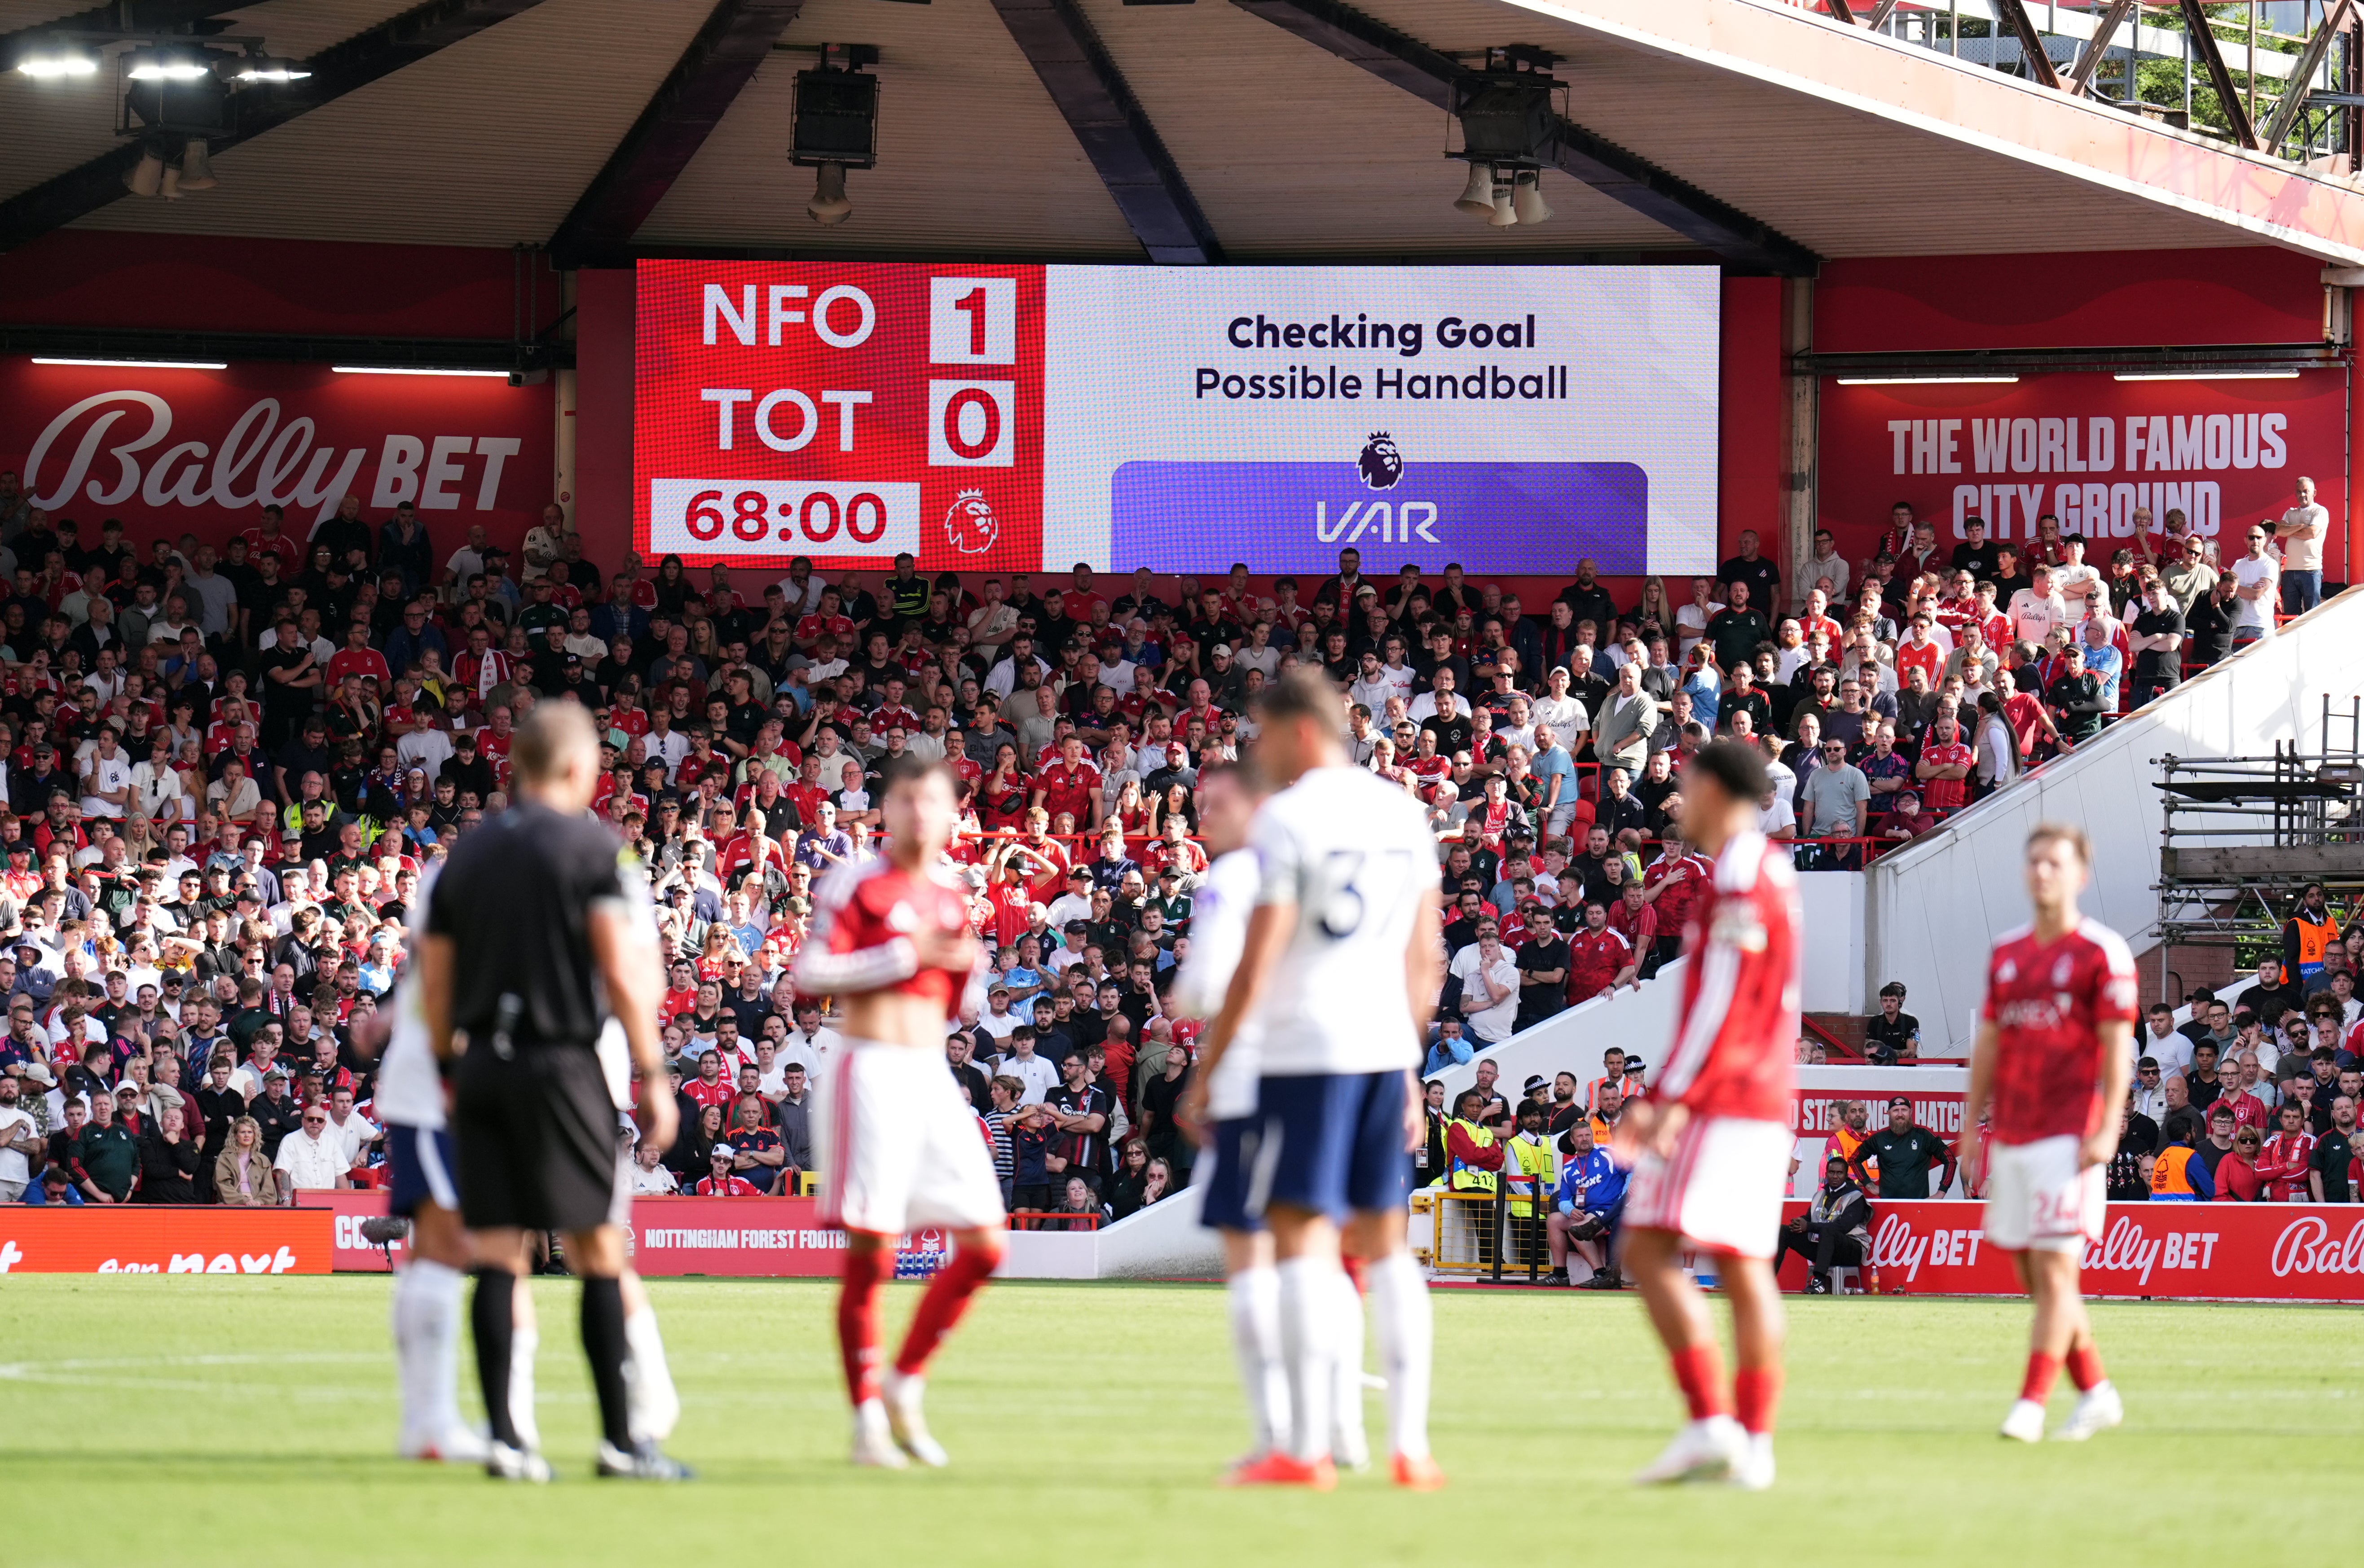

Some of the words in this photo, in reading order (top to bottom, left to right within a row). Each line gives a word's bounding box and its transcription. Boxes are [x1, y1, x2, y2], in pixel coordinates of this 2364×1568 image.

[703, 283, 876, 348] NFO
[955, 287, 986, 355] 1
[1228, 312, 1423, 357] Checking
[1436, 312, 1536, 349] Goal
[1196, 365, 1363, 400] Possible
[1376, 364, 1567, 400] Handball
[700, 388, 873, 452] TOT
[944, 387, 1001, 459] 0
[1888, 418, 1962, 474] THE
[1972, 416, 2115, 474] WORLD
[2125, 412, 2287, 471] FAMOUS
[23, 389, 366, 542] Bally
[370, 434, 522, 510] BET
[685, 489, 888, 544] 68:00
[1316, 501, 1441, 543] VAR
[1953, 483, 2044, 539] CITY
[2055, 480, 2221, 539] GROUND
[2021, 612, 2045, 623] Bally's
[1320, 848, 1413, 939] 37
[1472, 1175, 1493, 1188] 412
[645, 1229, 739, 1249] NOTTINGHAM
[741, 1230, 796, 1249] FOREST
[1929, 1230, 1985, 1266] BET
[2162, 1232, 2219, 1269] BET
